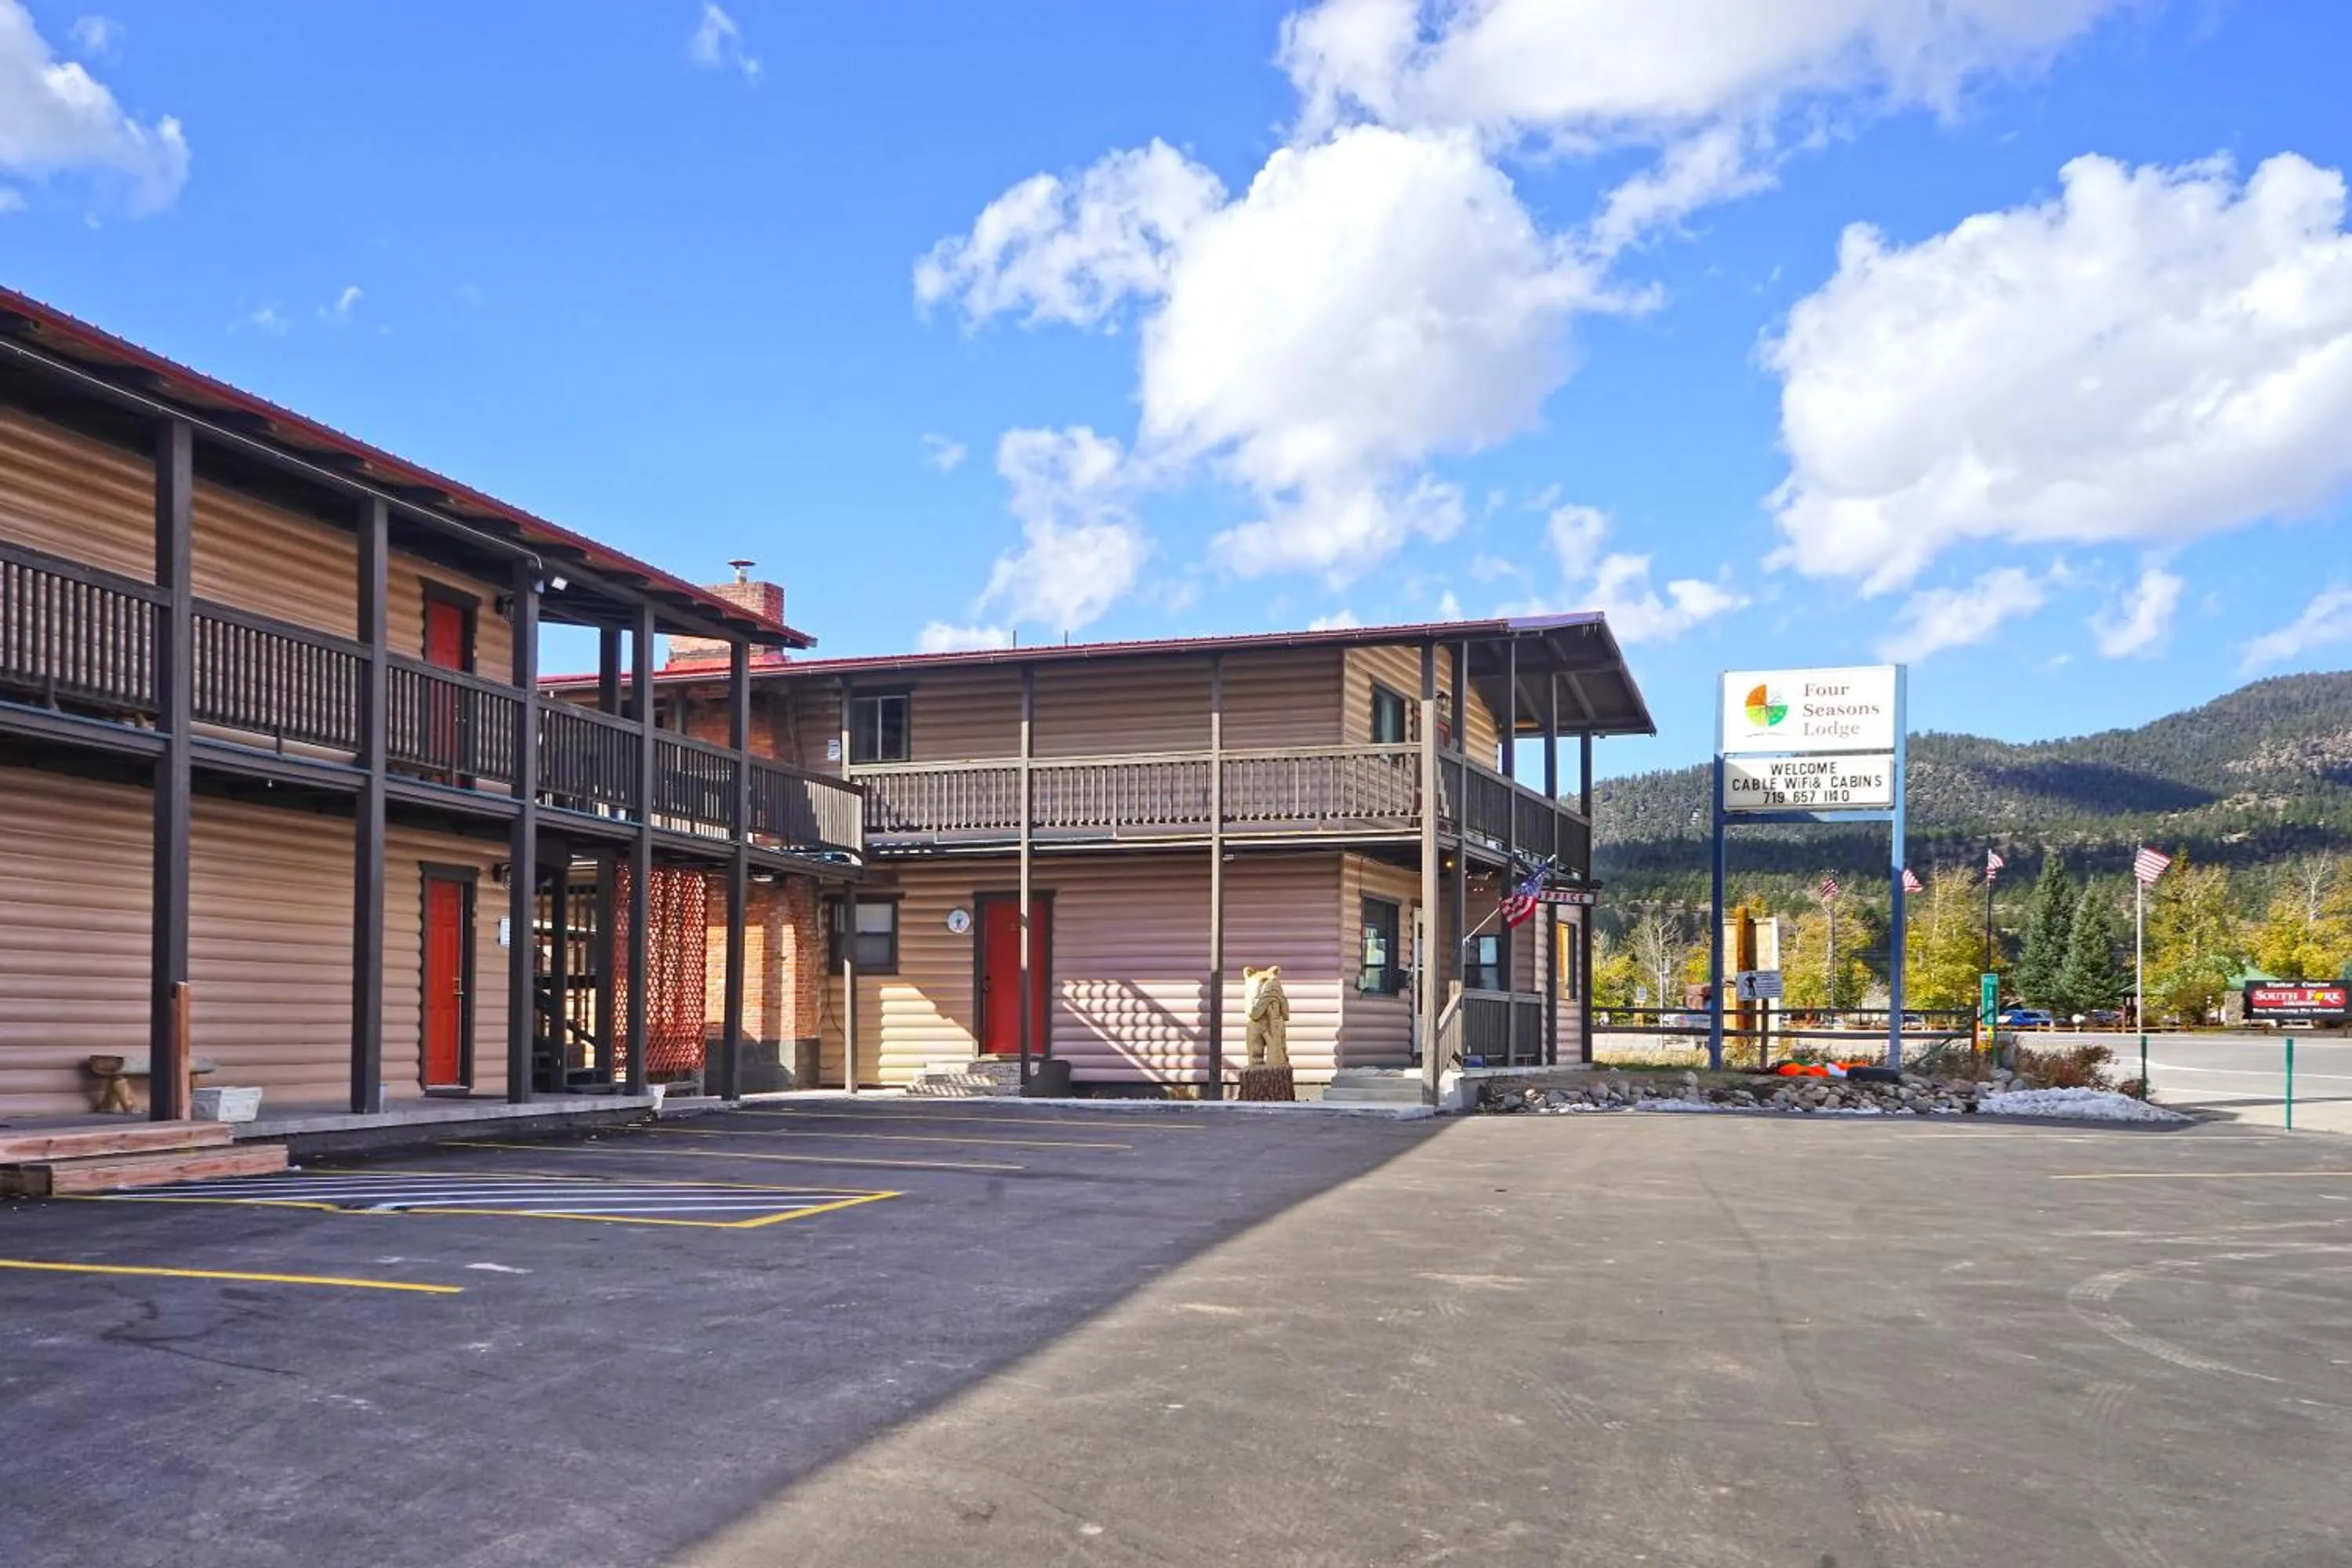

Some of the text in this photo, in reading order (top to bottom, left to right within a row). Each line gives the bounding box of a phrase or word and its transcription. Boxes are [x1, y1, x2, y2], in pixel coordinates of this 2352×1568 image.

[1803, 683, 1850, 697] Four
[1802, 702, 1881, 717] Seasons
[1803, 720, 1860, 739] Lodge
[1770, 761, 1838, 775] WELCOME
[1732, 777, 1777, 791] CABLE
[1831, 775, 1882, 788] CABINS
[1763, 790, 1785, 804] 719
[1793, 790, 1817, 803] 657
